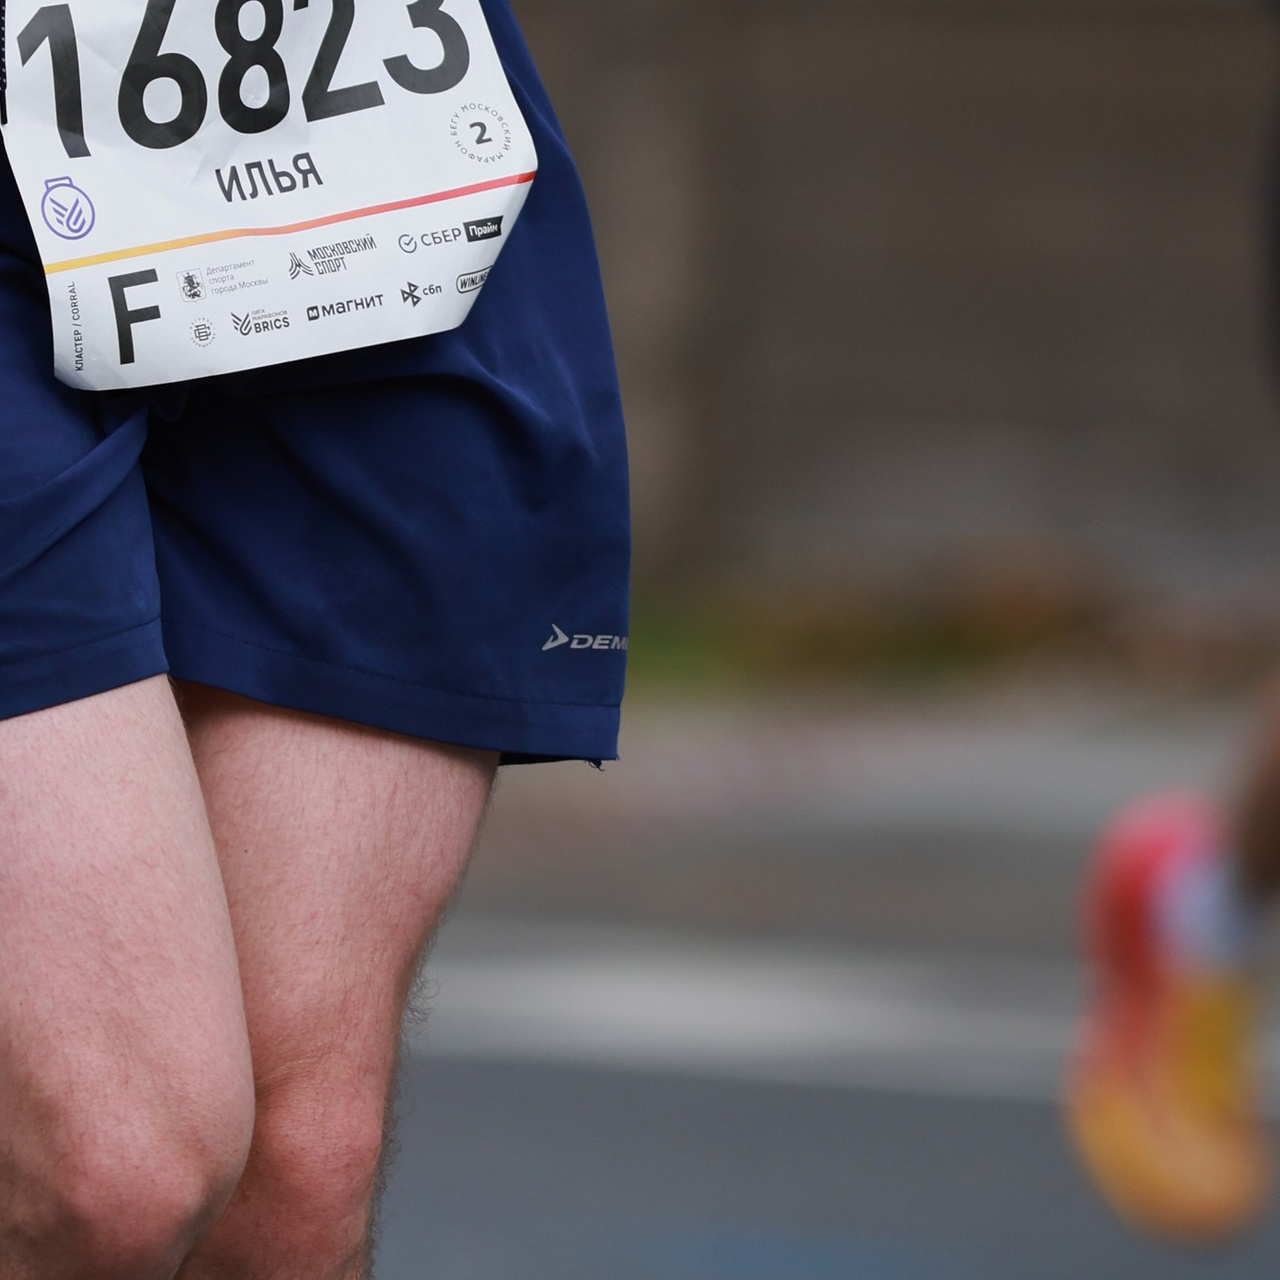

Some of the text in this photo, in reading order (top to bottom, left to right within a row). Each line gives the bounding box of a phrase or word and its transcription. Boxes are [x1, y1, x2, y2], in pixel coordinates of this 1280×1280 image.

[469, 121, 493, 145] 2
[215, 152, 324, 202] ИЛЬЯ
[420, 222, 498, 246] СБЕР Прайм
[306, 233, 377, 261] МОСКОВСКИЙ
[206, 260, 255, 276] Департамент
[314, 256, 347, 275] СПОРТ
[209, 274, 235, 286] спорта
[211, 278, 268, 295] города Москвы
[68, 281, 80, 321] CORRAL
[107, 268, 161, 365] F
[253, 316, 290, 334] BRICS
[74, 329, 84, 372] КЛАСТЕР
